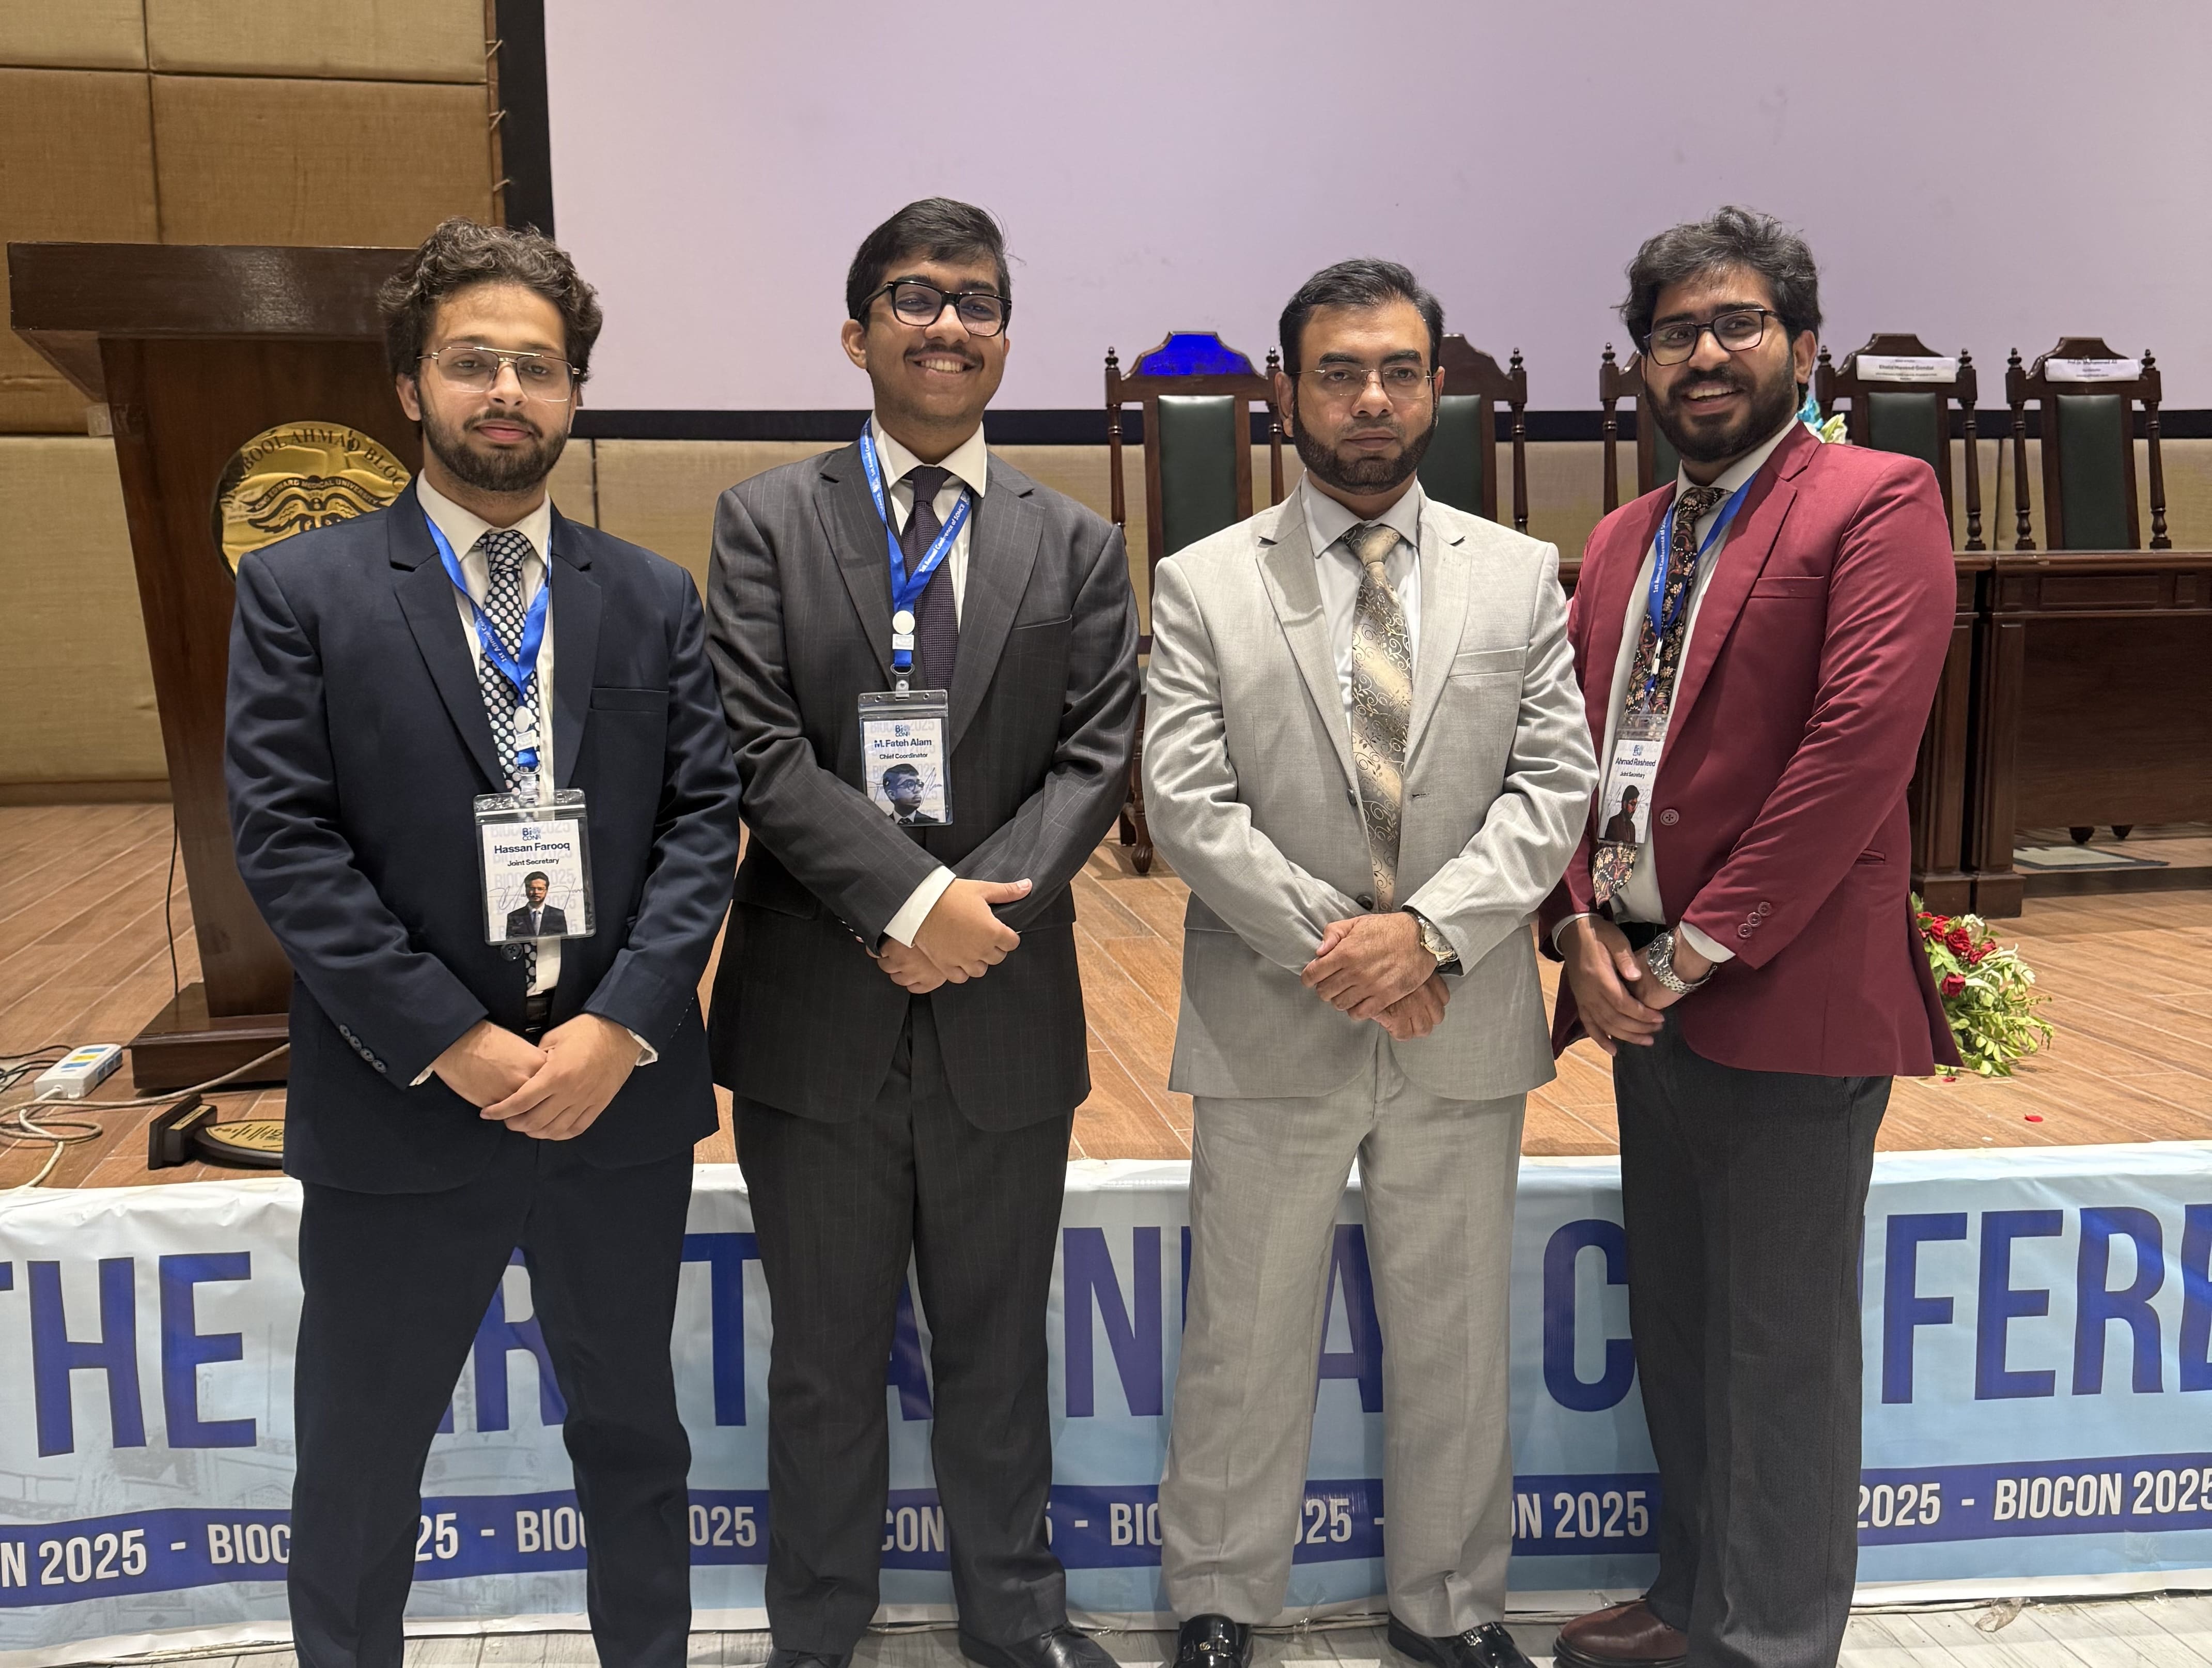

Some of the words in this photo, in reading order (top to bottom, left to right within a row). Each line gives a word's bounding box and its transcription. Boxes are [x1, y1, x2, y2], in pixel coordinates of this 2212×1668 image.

[364, 447, 407, 489] BLOC
[885, 739, 909, 747] Fateh
[1633, 758, 1657, 766] Rasheed
[494, 845, 533, 854] Hassan
[535, 842, 571, 851] Farooq
[40, 1528, 147, 1586] 2025
[208, 1523, 291, 1565] BIOC
[415, 1512, 459, 1562] 25
[516, 1507, 586, 1553] BIO
[689, 1504, 757, 1547] 025
[881, 1506, 946, 1553] CON
[1295, 1498, 1352, 1544] 25
[1554, 1491, 1649, 1538] 2025
[1993, 1473, 2122, 1520] BIOCON
